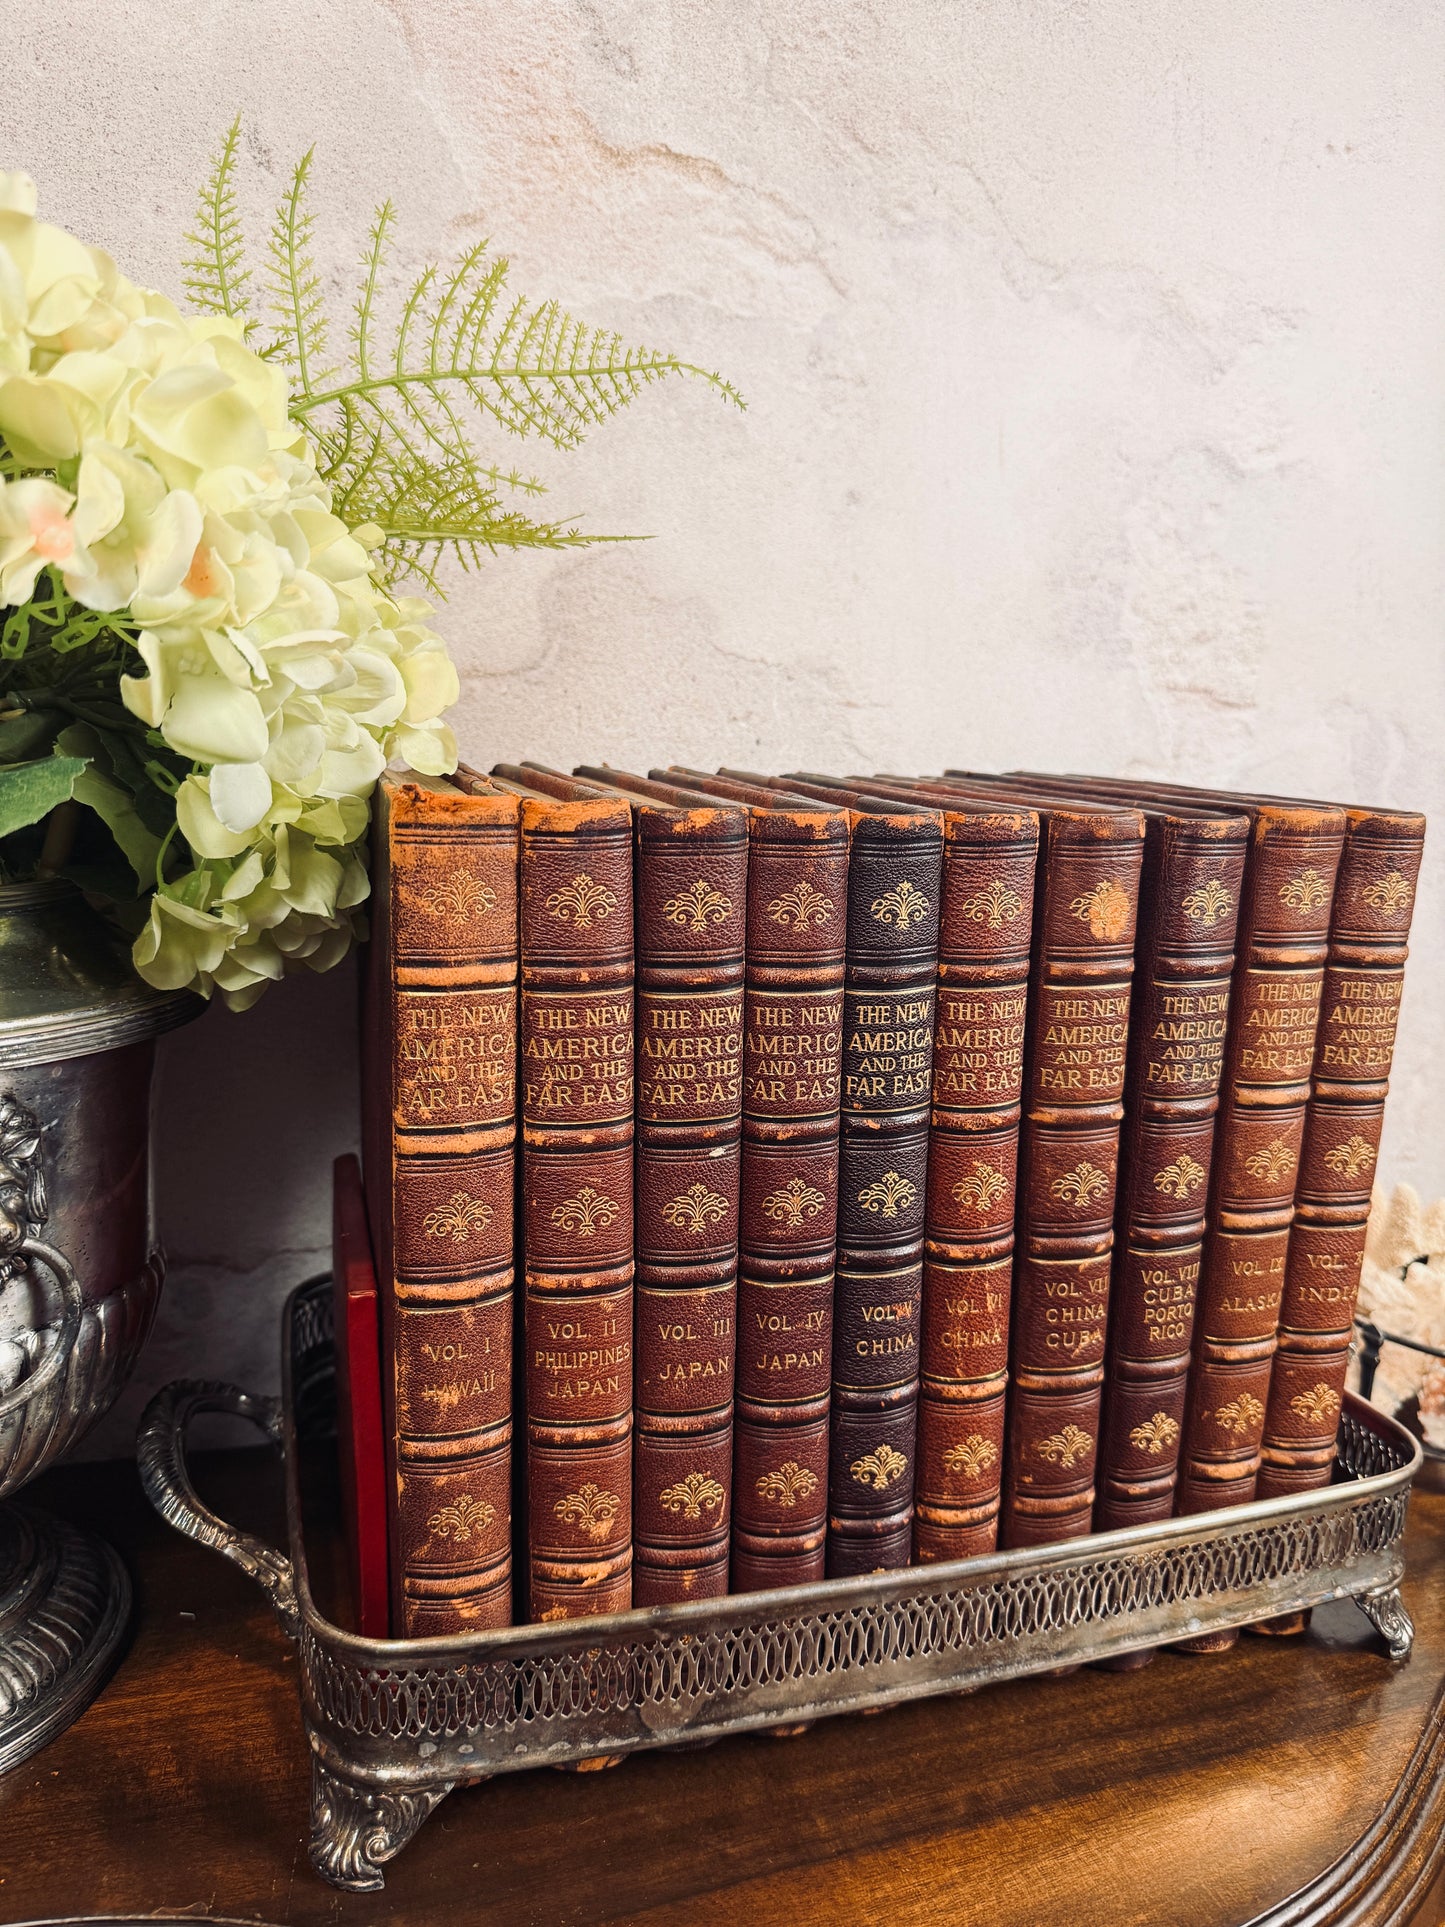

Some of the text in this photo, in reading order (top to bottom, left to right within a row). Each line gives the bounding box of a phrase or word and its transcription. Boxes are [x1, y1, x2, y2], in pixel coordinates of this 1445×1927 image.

[1257, 980, 1324, 1001] THE NEW
[1340, 981, 1371, 999] THE
[856, 1000, 930, 1025] THE NEW
[948, 997, 1027, 1022] THE NEW
[1053, 997, 1130, 1018] THE NEW
[1163, 993, 1230, 1015] THE NEW
[410, 1003, 511, 1028] THE NEW
[535, 1003, 631, 1029] THE NEW
[651, 1003, 742, 1029] THE NEW
[756, 1003, 843, 1027] THE NEW
[1328, 1006, 1398, 1024] AMERIC
[850, 1028, 933, 1052] AMERICA
[1044, 1023, 1129, 1046] AMERICA
[1256, 1029, 1314, 1045] AND THE
[1337, 1027, 1394, 1042] AND THE
[399, 1033, 515, 1060] AMERICA
[525, 1033, 633, 1059] AMERICA
[1055, 1047, 1123, 1064] AND THE
[1162, 1042, 1222, 1060] AND THE
[1322, 1045, 1361, 1064] FAR
[757, 1056, 837, 1077] AND THE
[859, 1052, 927, 1073] AND THE
[949, 1048, 1021, 1068] AND THE
[1240, 1049, 1279, 1068] FAR
[413, 1059, 505, 1083] AND THE
[540, 1059, 627, 1081] AND THE
[655, 1058, 739, 1080] AND THE
[934, 1068, 978, 1091] FAR
[1040, 1067, 1083, 1088] FAR
[1147, 1062, 1185, 1083] FAR
[640, 1083, 685, 1105] FAR
[846, 1070, 931, 1097] FAR EAST
[400, 1087, 448, 1110] FAR
[526, 1085, 573, 1107] FAR
[1269, 1256, 1284, 1272] IX
[1354, 1250, 1364, 1265] X
[1179, 1261, 1200, 1281] VIII
[1088, 1276, 1109, 1294] VII
[1143, 1283, 1195, 1305] CUBA
[1299, 1286, 1359, 1302] INDIA
[987, 1293, 1001, 1312] VI
[1046, 1303, 1106, 1323] CHINA
[806, 1310, 825, 1329] IV
[1143, 1303, 1193, 1324] PORTO
[604, 1319, 617, 1335] II
[713, 1318, 730, 1336] III
[941, 1327, 1002, 1348] CHINA
[1046, 1327, 1102, 1348] CUBA
[1149, 1324, 1185, 1341] RICO
[485, 1337, 491, 1353] I
[856, 1331, 915, 1356] CHINA
[535, 1341, 631, 1369] PHILIPPINES
[757, 1348, 823, 1371] JAPAN
[660, 1358, 729, 1381] JAPAN
[547, 1376, 619, 1398] JAPAN
